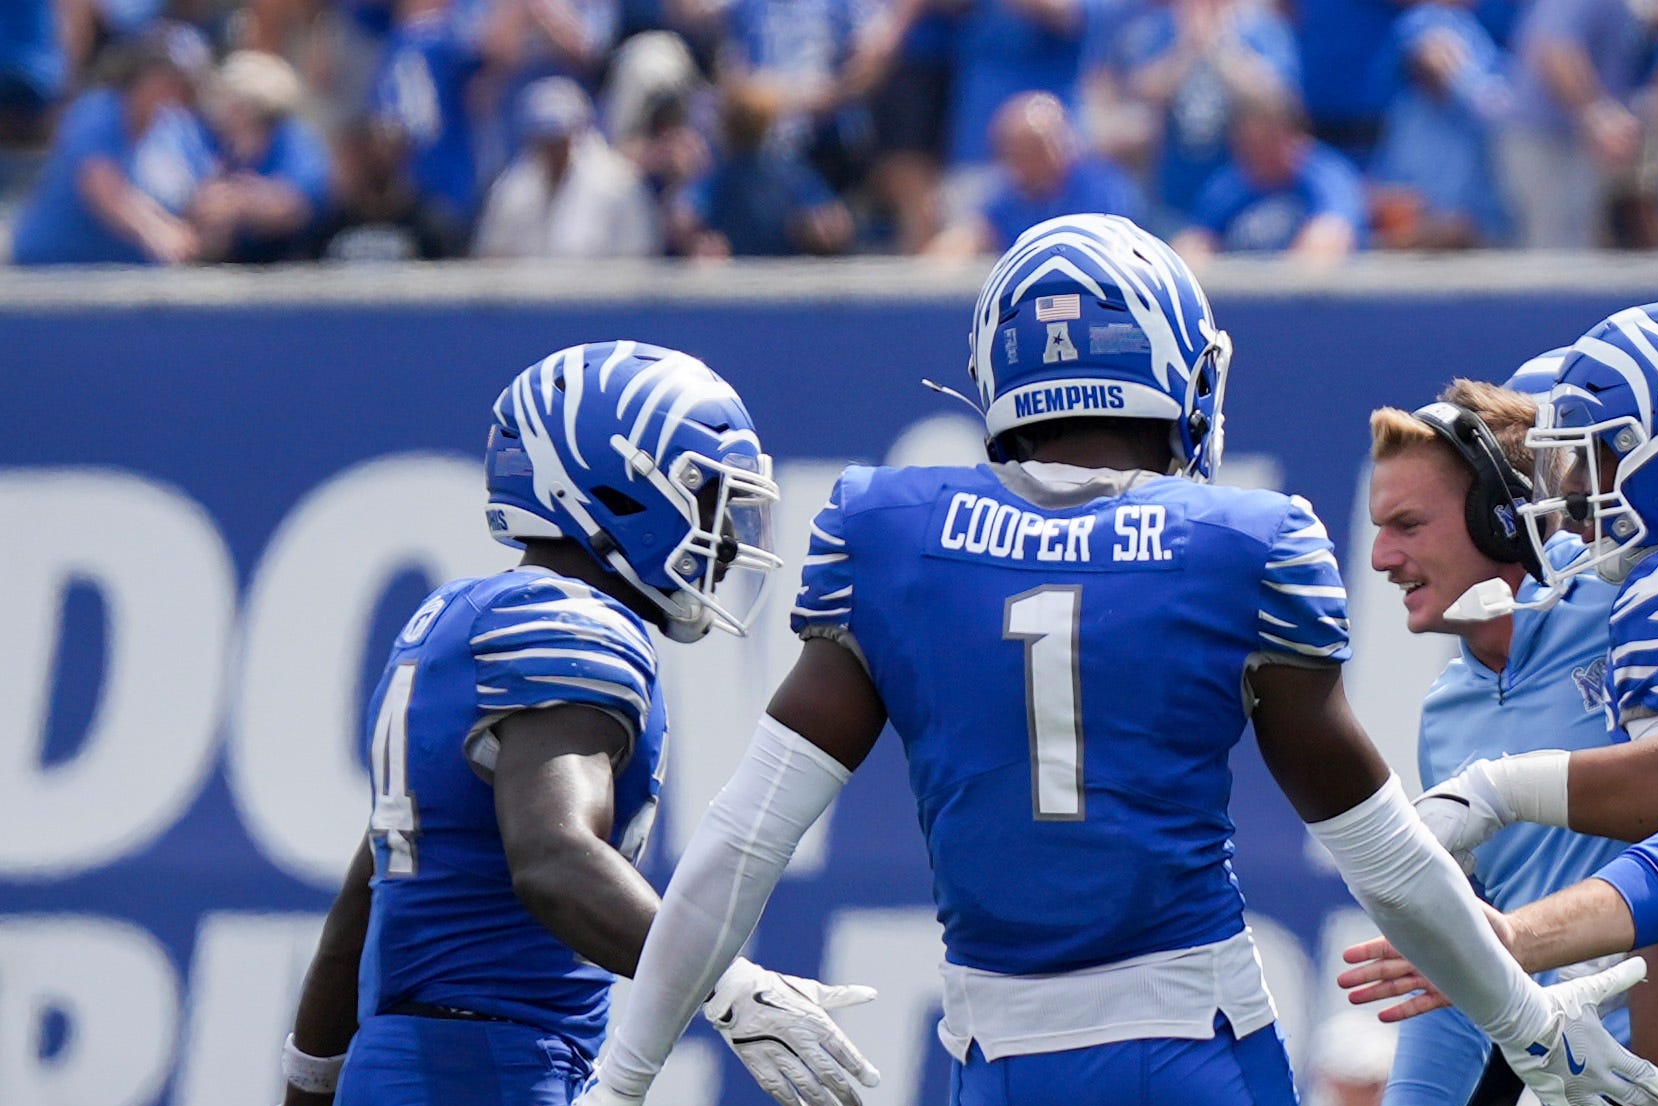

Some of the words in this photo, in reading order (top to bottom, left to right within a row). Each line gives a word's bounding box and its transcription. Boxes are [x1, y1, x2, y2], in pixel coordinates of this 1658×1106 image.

[1014, 385, 1125, 419] MEMPHIS
[941, 492, 1096, 562] COOPER
[1113, 505, 1173, 562] SR.
[369, 658, 418, 877] 4
[1002, 584, 1086, 821] 1
